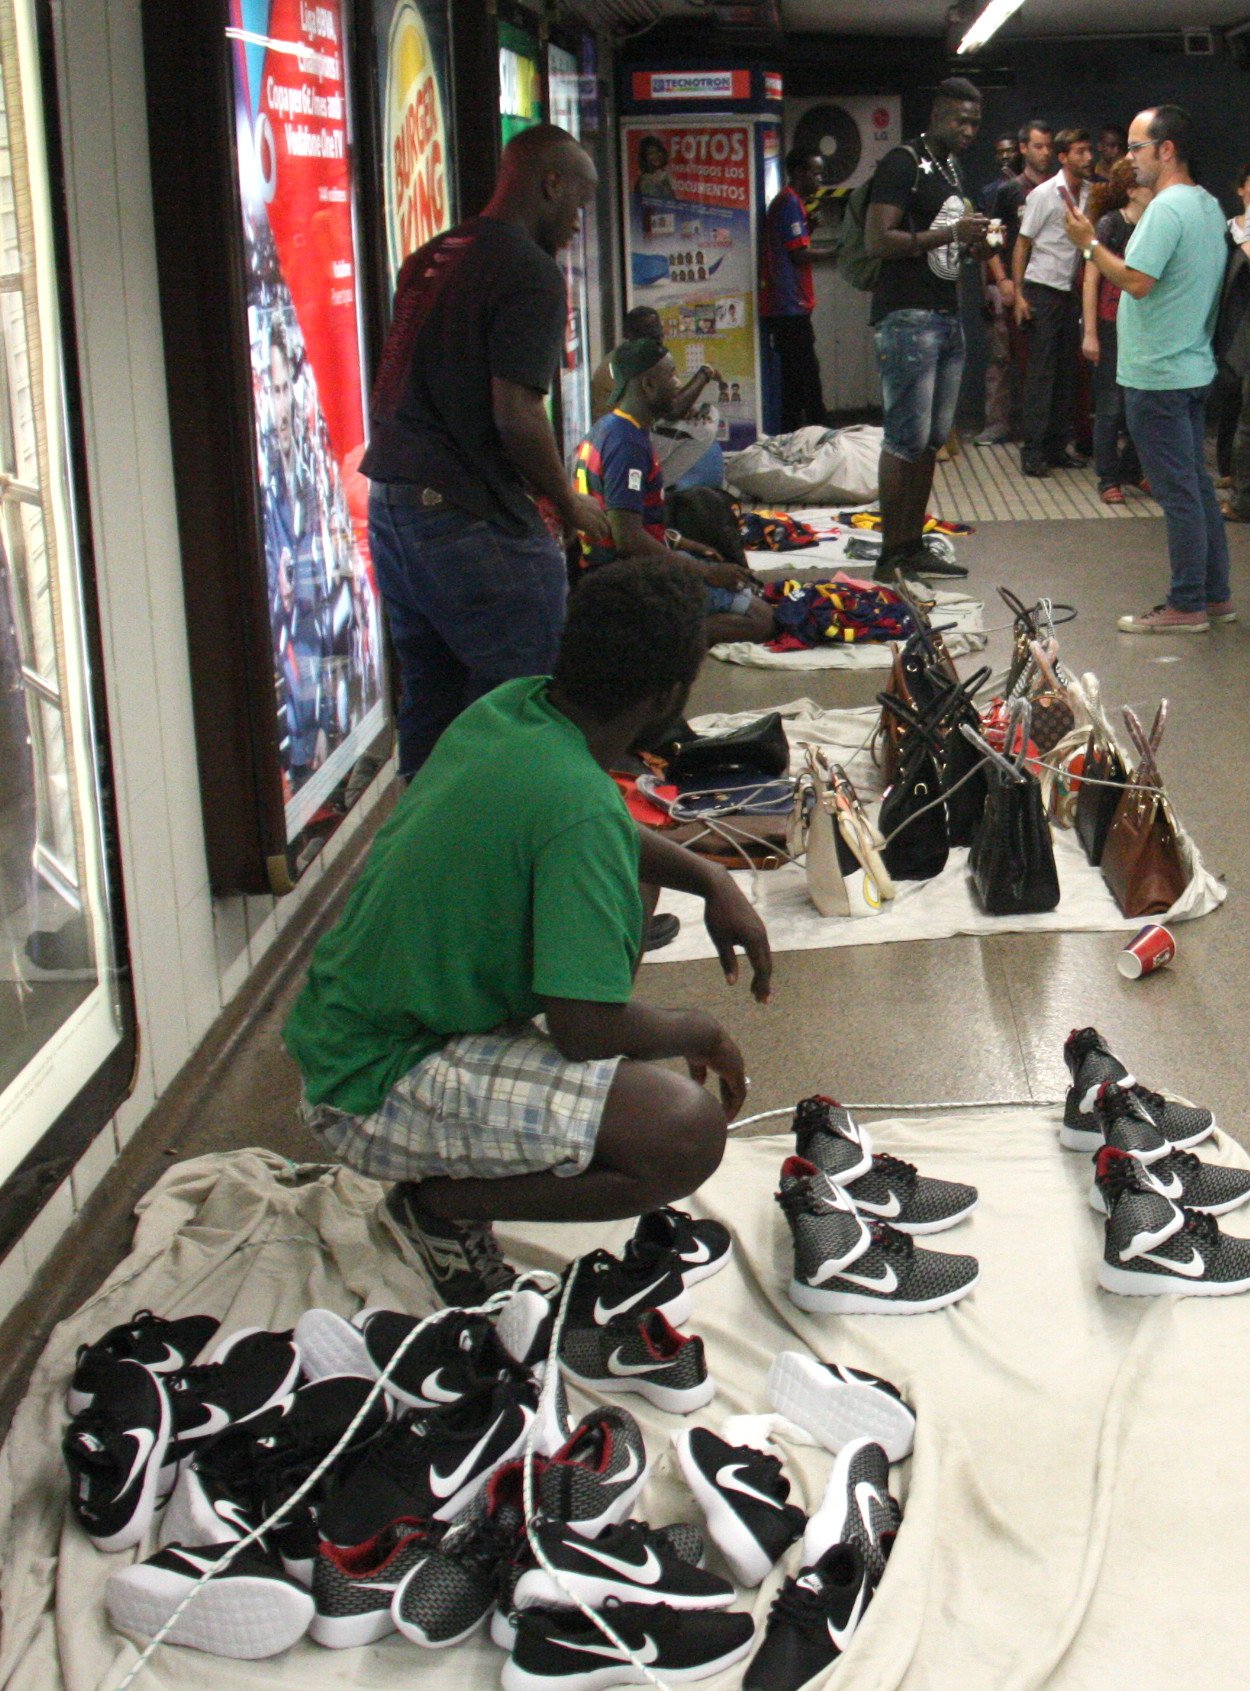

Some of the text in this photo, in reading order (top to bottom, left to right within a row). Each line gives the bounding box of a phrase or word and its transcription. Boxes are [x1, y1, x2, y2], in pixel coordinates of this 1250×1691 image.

[664, 77, 730, 88] TECNOTRON
[394, 76, 437, 215] BURGER
[670, 132, 745, 161] FOTOS
[873, 131, 889, 142] LG
[724, 167, 745, 179] LOS
[402, 139, 444, 259] KING
[671, 179, 746, 201] DOCUMENTOS
